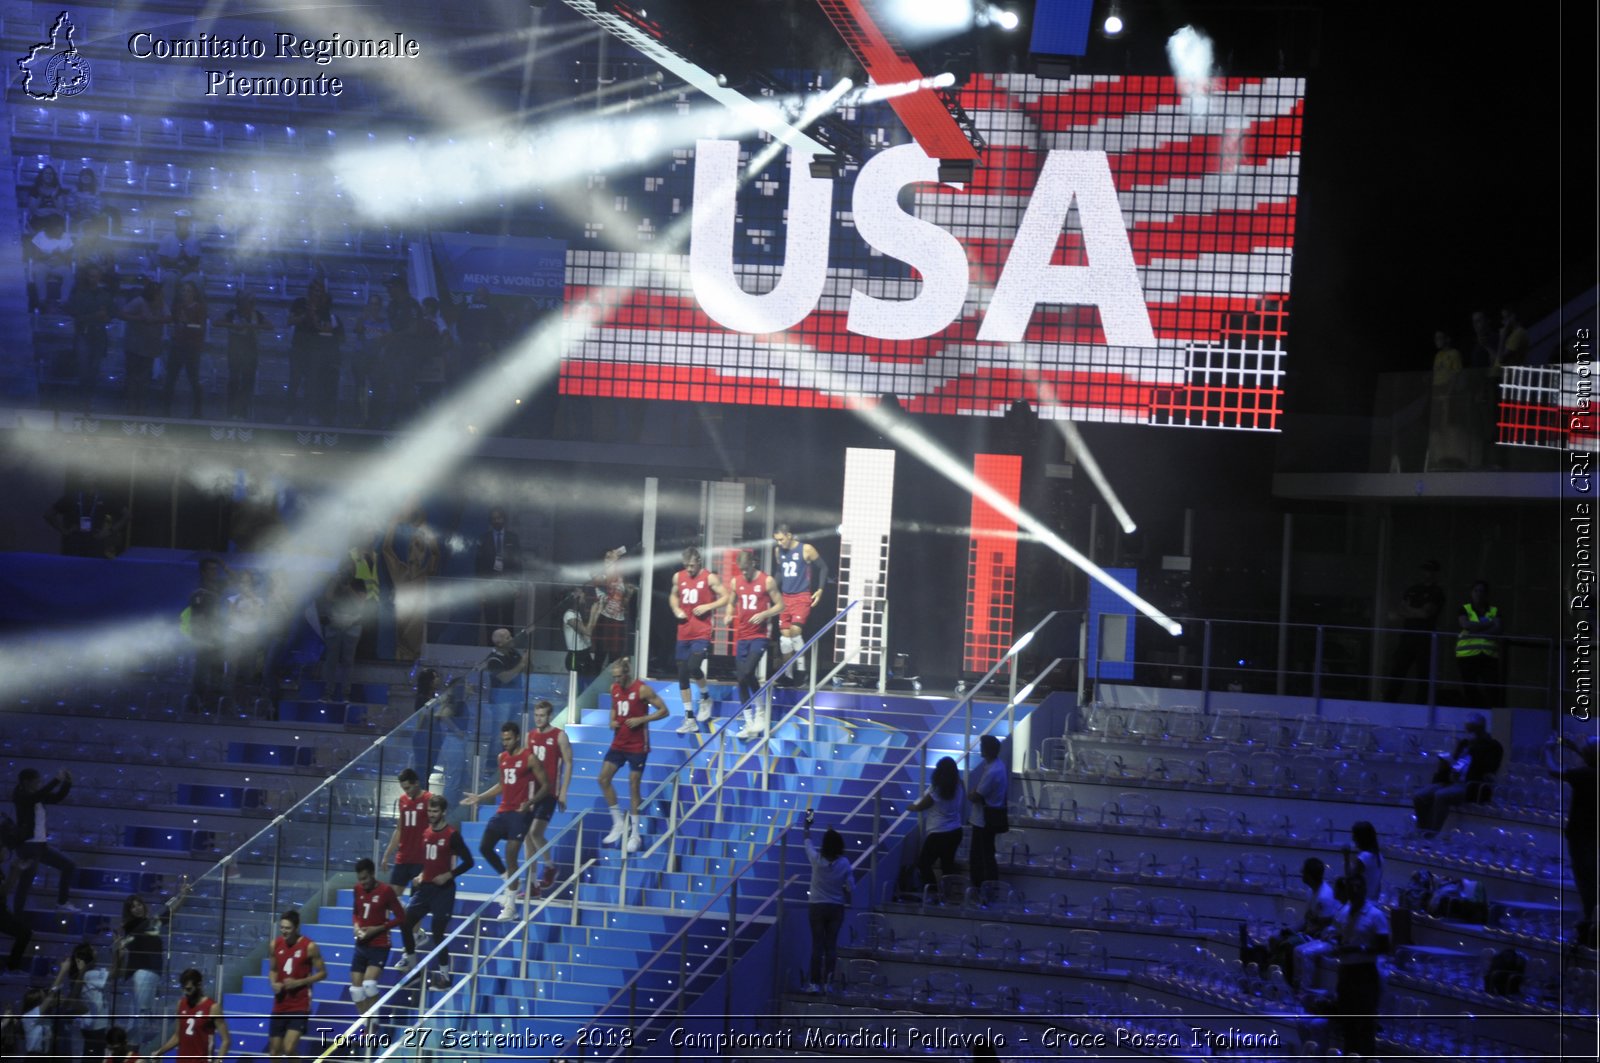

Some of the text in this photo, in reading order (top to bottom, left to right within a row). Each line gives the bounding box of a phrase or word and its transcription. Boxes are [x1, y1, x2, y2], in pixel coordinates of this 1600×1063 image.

[689, 138, 1158, 347] USA
[503, 275, 545, 288] WORLD
[782, 561, 798, 577] 22
[682, 588, 699, 604] 20
[741, 594, 758, 610] 12
[617, 700, 630, 716] 19
[504, 768, 517, 784] 13
[405, 810, 416, 826] 11
[426, 843, 438, 860] 10
[363, 902, 371, 920] 7
[283, 957, 293, 975] 4
[185, 1017, 195, 1036] 2
